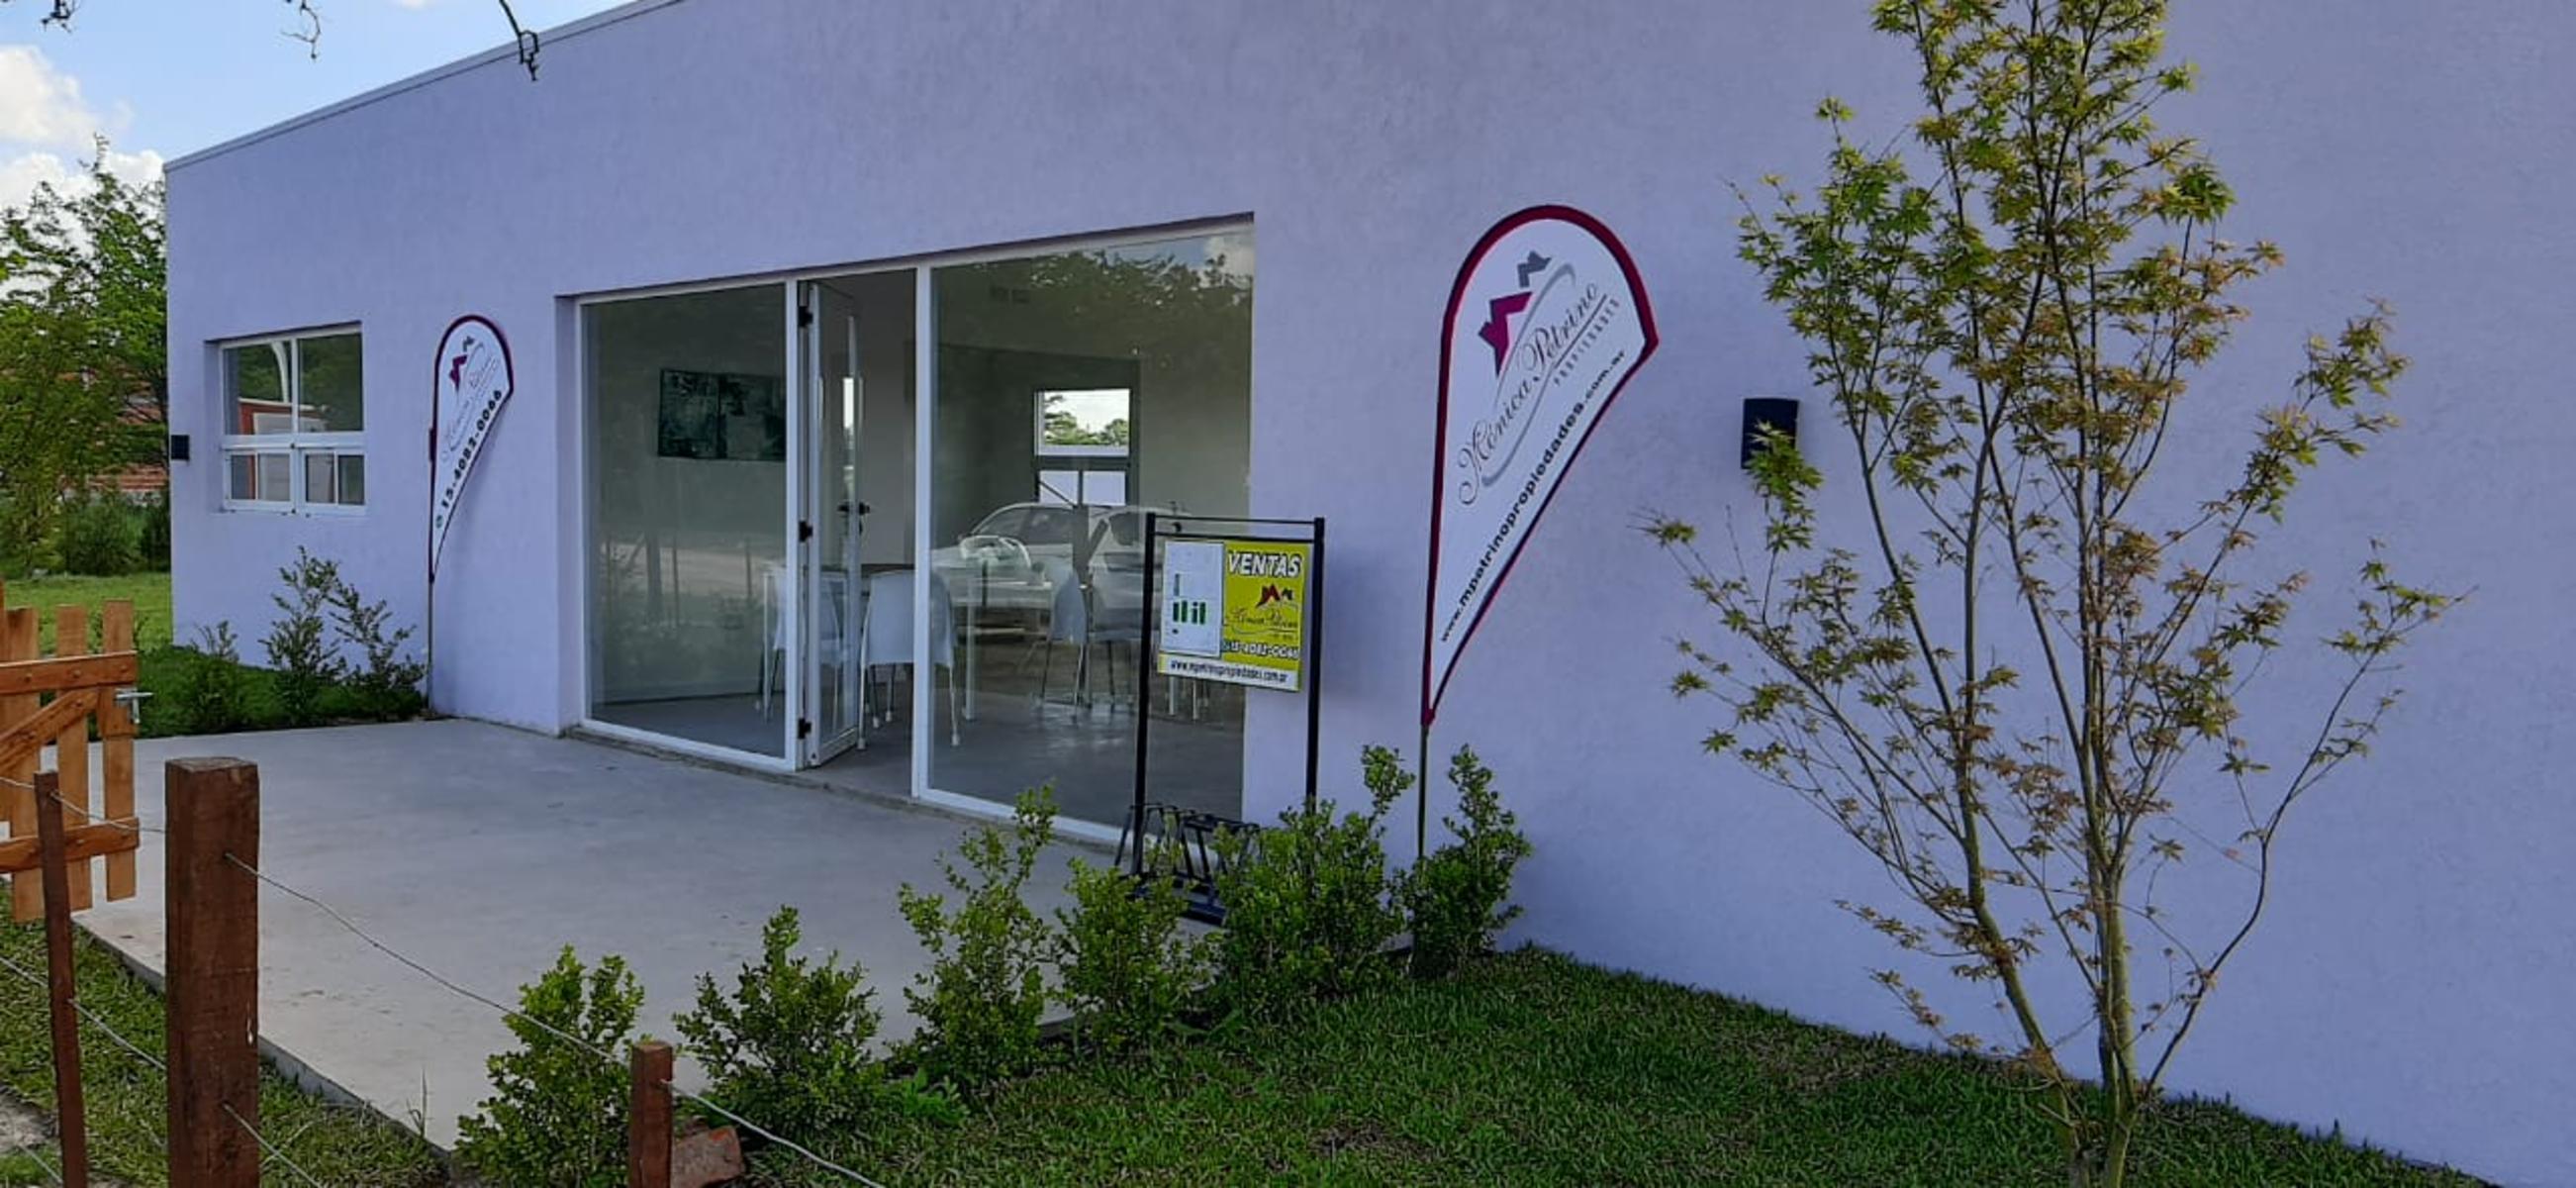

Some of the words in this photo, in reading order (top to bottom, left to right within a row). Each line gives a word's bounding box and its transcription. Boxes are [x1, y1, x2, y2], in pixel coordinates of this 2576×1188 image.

[1441, 349, 1626, 643] www.mpetrinopropiedades.com.ar
[1458, 376, 1533, 506] Mónica
[1519, 282, 1599, 382] Petrino
[1227, 549, 1301, 578] VENTAS
